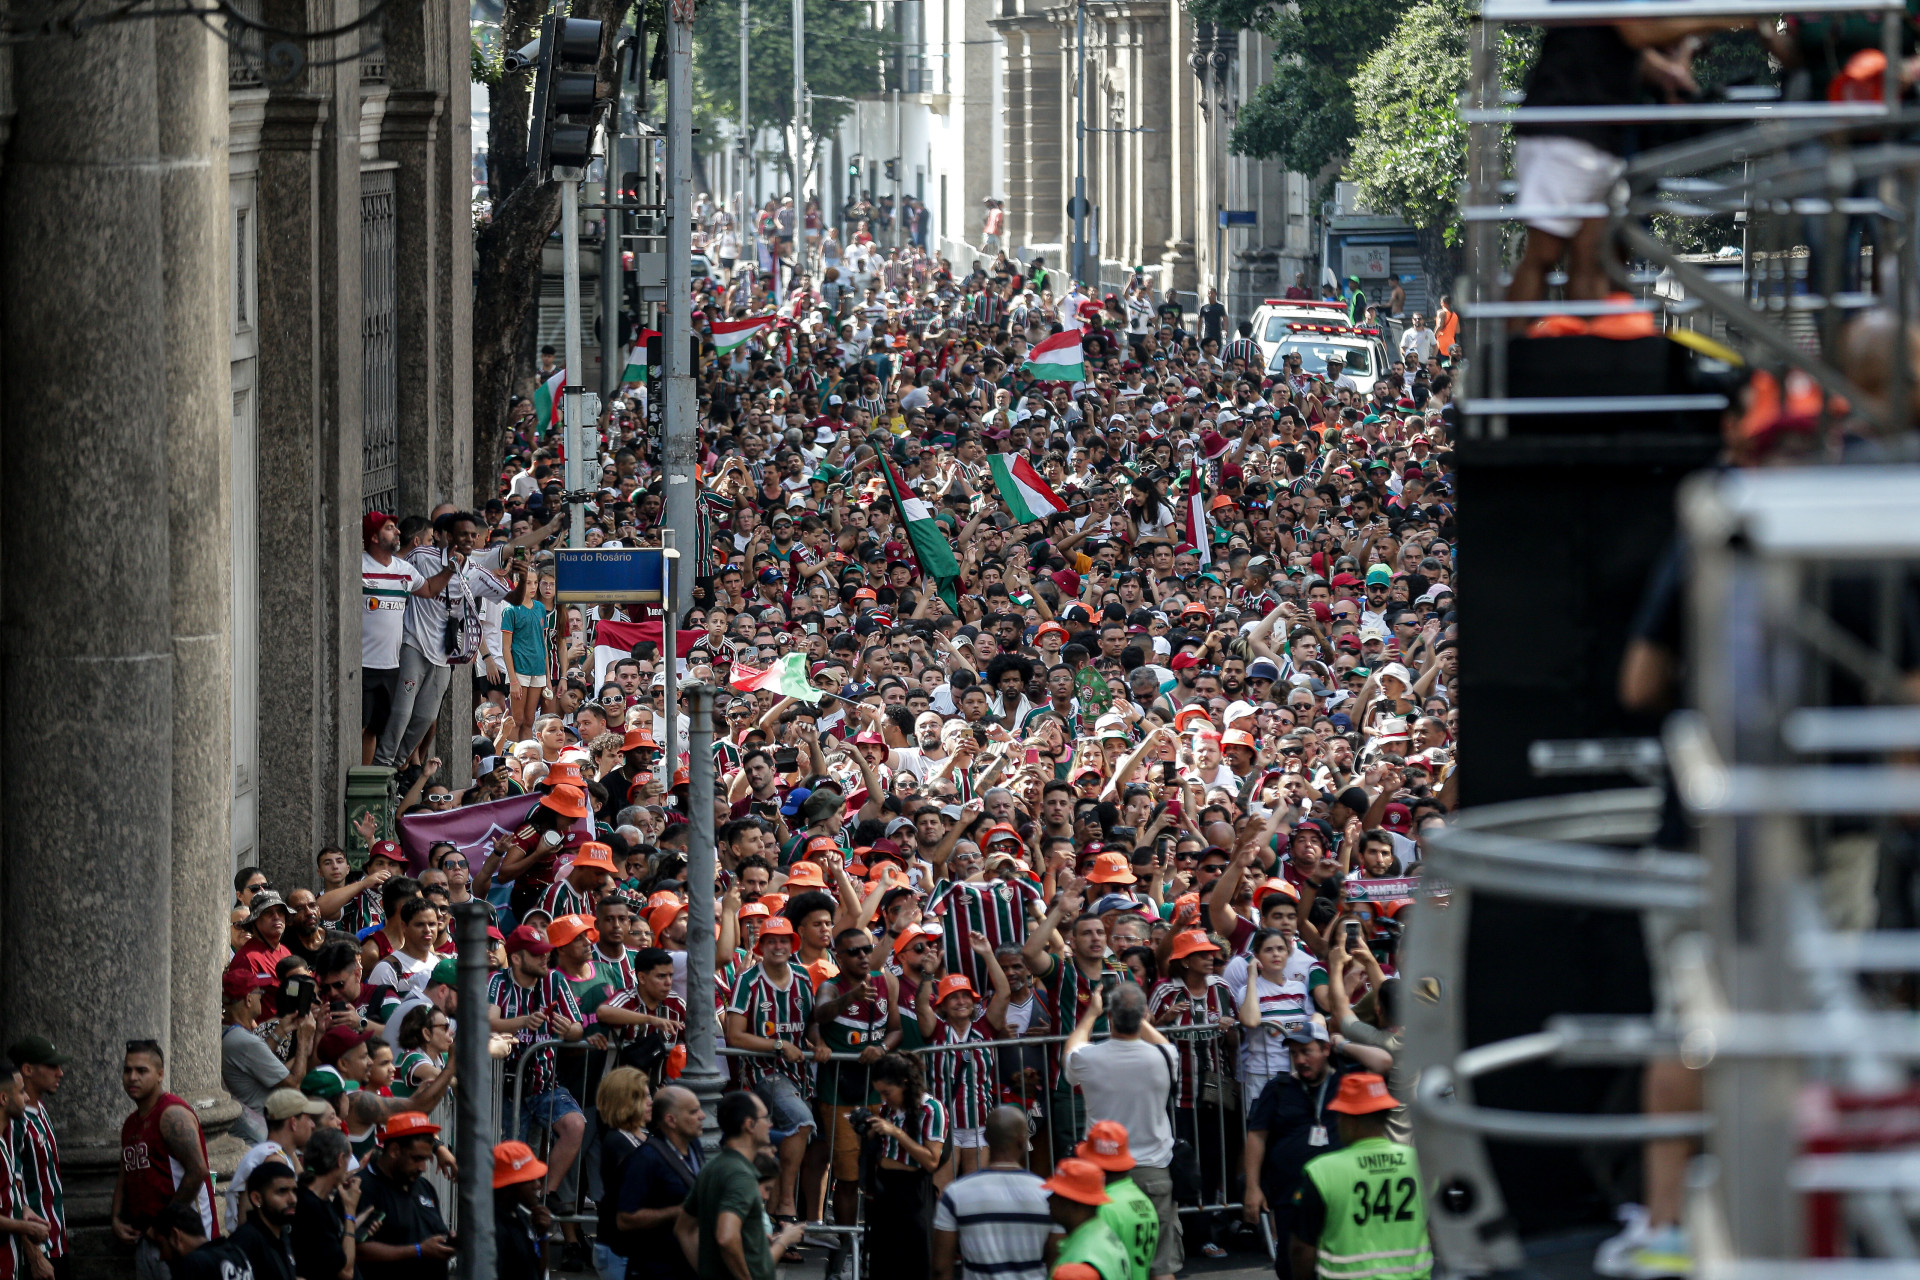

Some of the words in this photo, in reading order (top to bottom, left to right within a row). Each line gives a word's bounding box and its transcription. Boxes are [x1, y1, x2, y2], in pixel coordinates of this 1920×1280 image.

[559, 553, 578, 562] Rua
[580, 553, 593, 562] do
[595, 552, 632, 562] Rosário
[1367, 882, 1409, 896] CAMPEÃO
[123, 1142, 150, 1172] 92
[1357, 1152, 1407, 1170] UNIPAZ
[1353, 1176, 1417, 1227] 342
